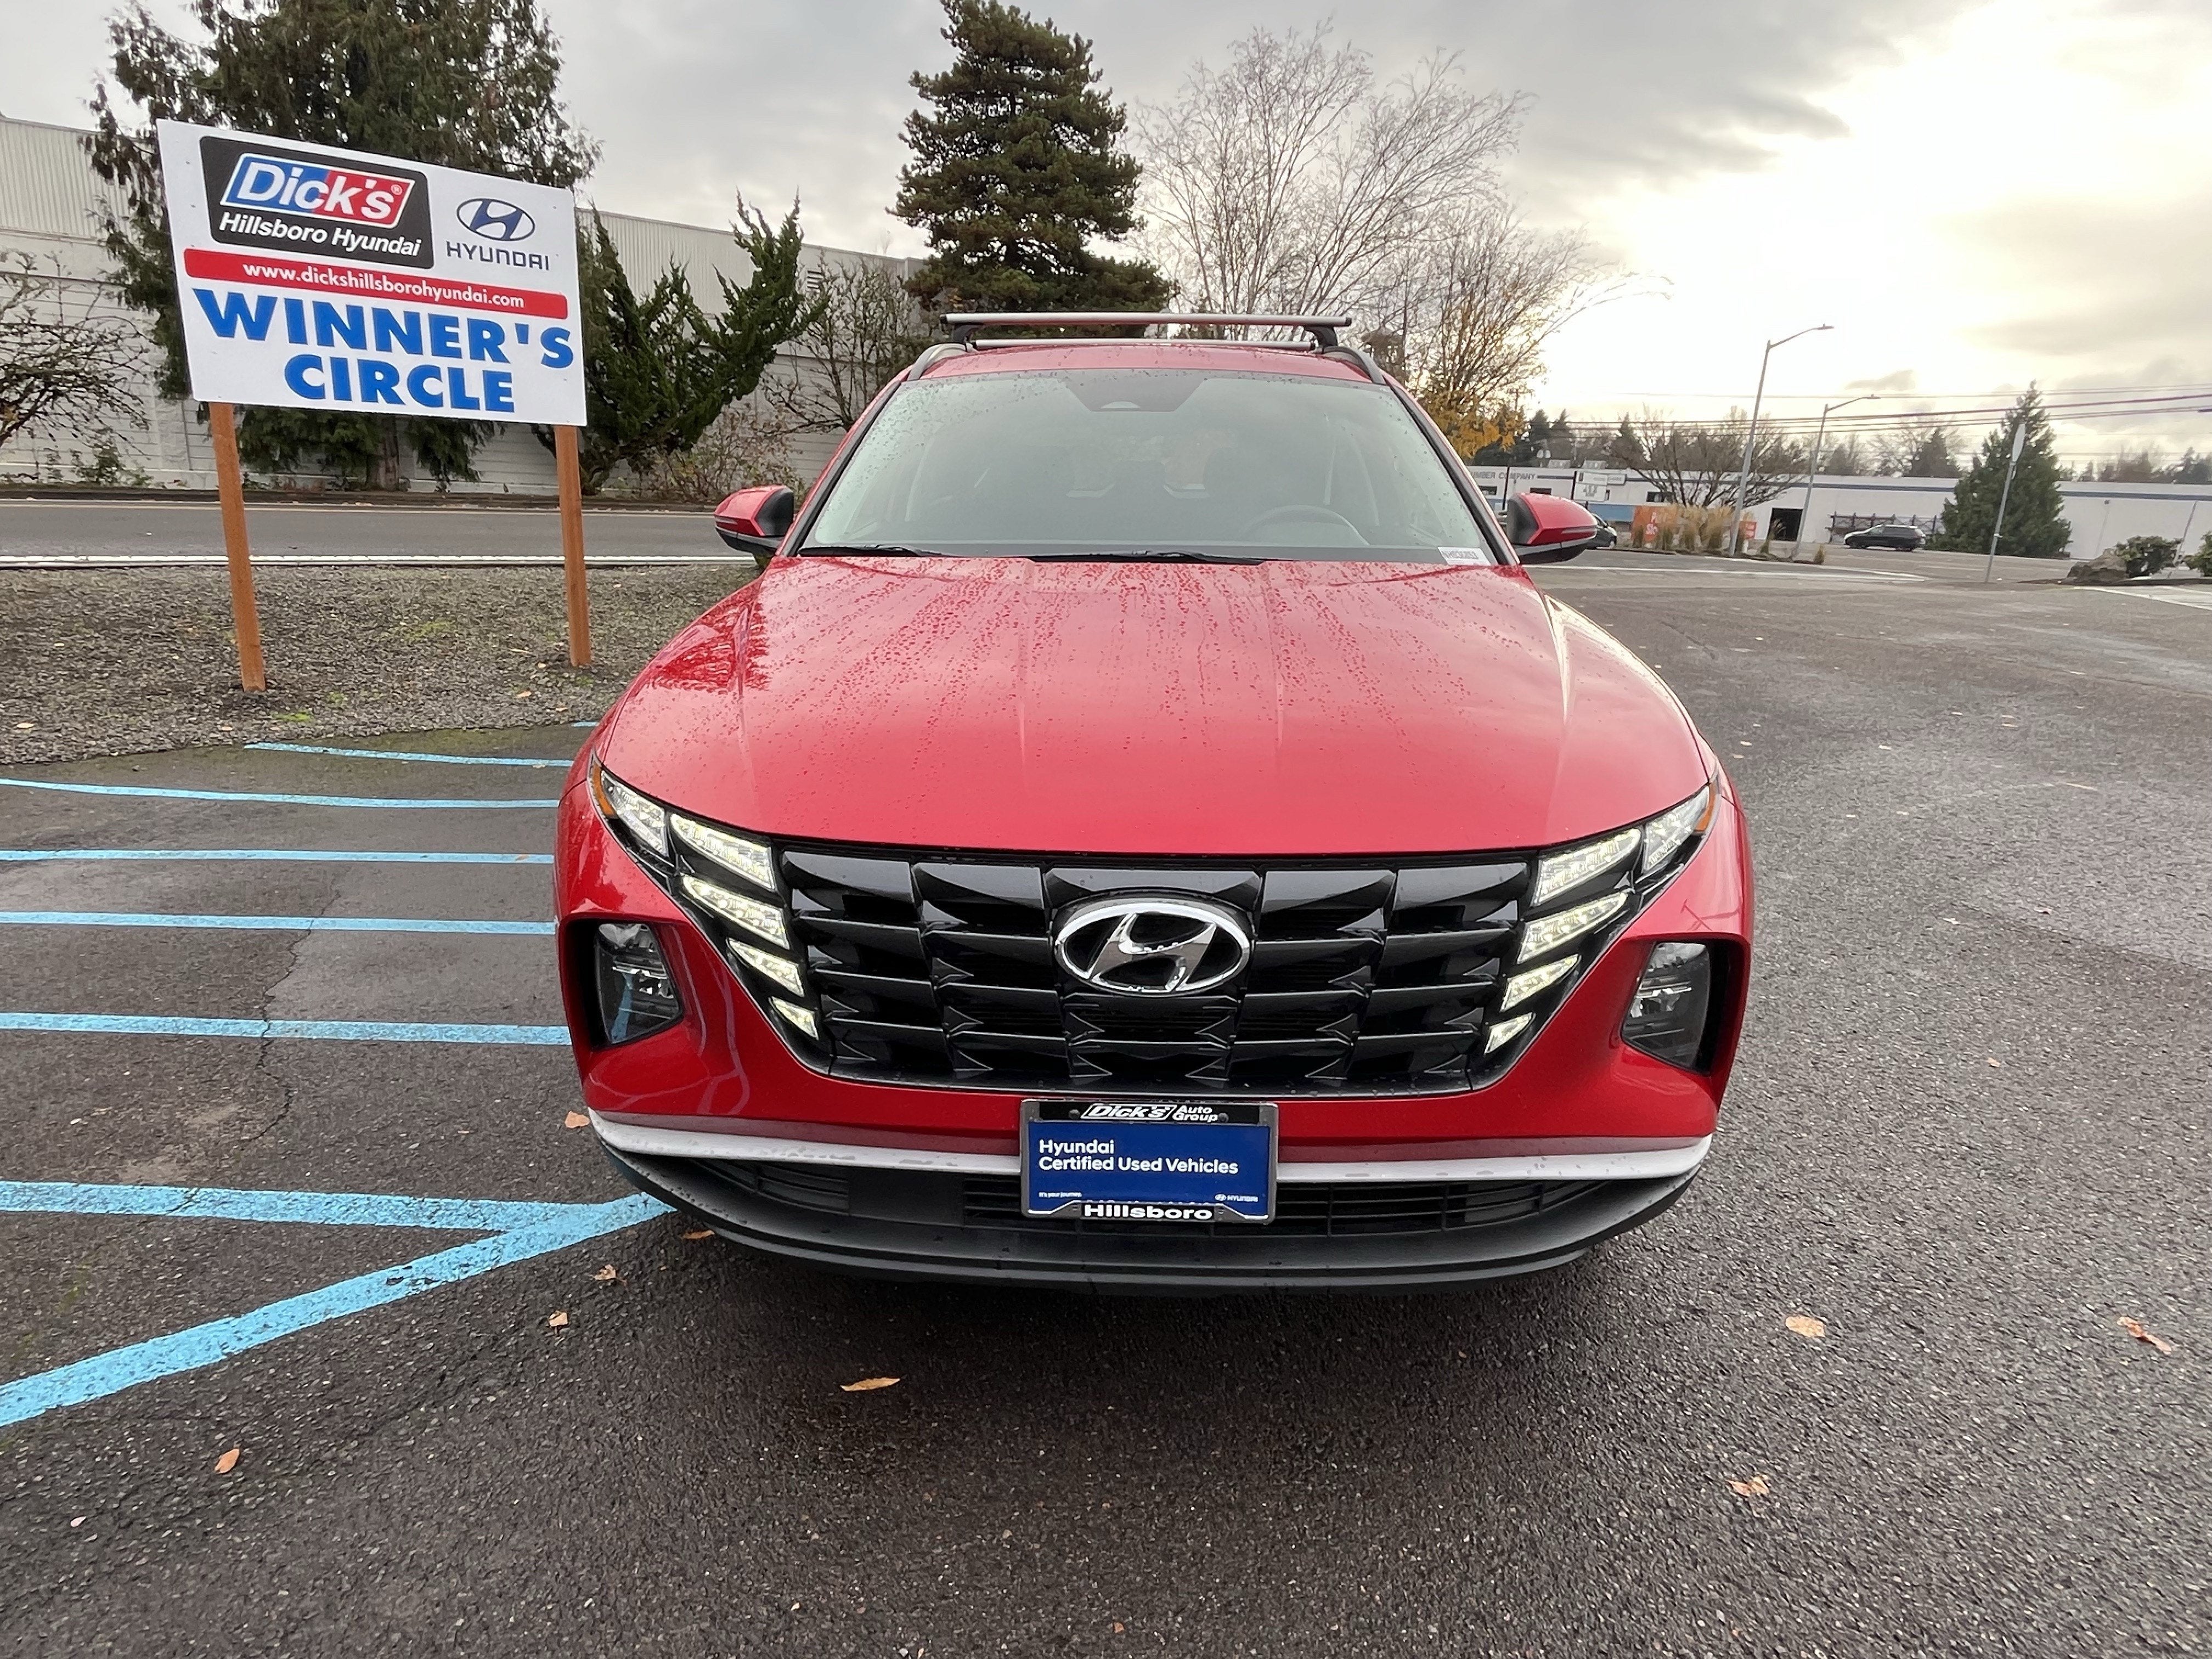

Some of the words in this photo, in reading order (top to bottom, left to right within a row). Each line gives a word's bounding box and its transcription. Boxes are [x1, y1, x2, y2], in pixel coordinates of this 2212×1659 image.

[236, 161, 394, 219] Dick's
[219, 211, 328, 244] Hillsboro
[331, 227, 422, 257] Hyundai
[446, 240, 550, 270] HYUNDAI
[242, 263, 524, 308] www.dickshillsborohyundai.com
[192, 288, 574, 369] WINNER'S
[284, 354, 515, 413] CIRCLE
[1088, 1104, 1166, 1118] Dick's
[1172, 1113, 1218, 1122] Group
[1179, 1105, 1212, 1114] Auto
[1039, 1139, 1115, 1156] Hyundai
[1039, 1156, 1114, 1171] Certified
[1118, 1157, 1163, 1172] Used
[1165, 1158, 1239, 1174] Vehicles
[1084, 1204, 1212, 1220] Hillsboro
